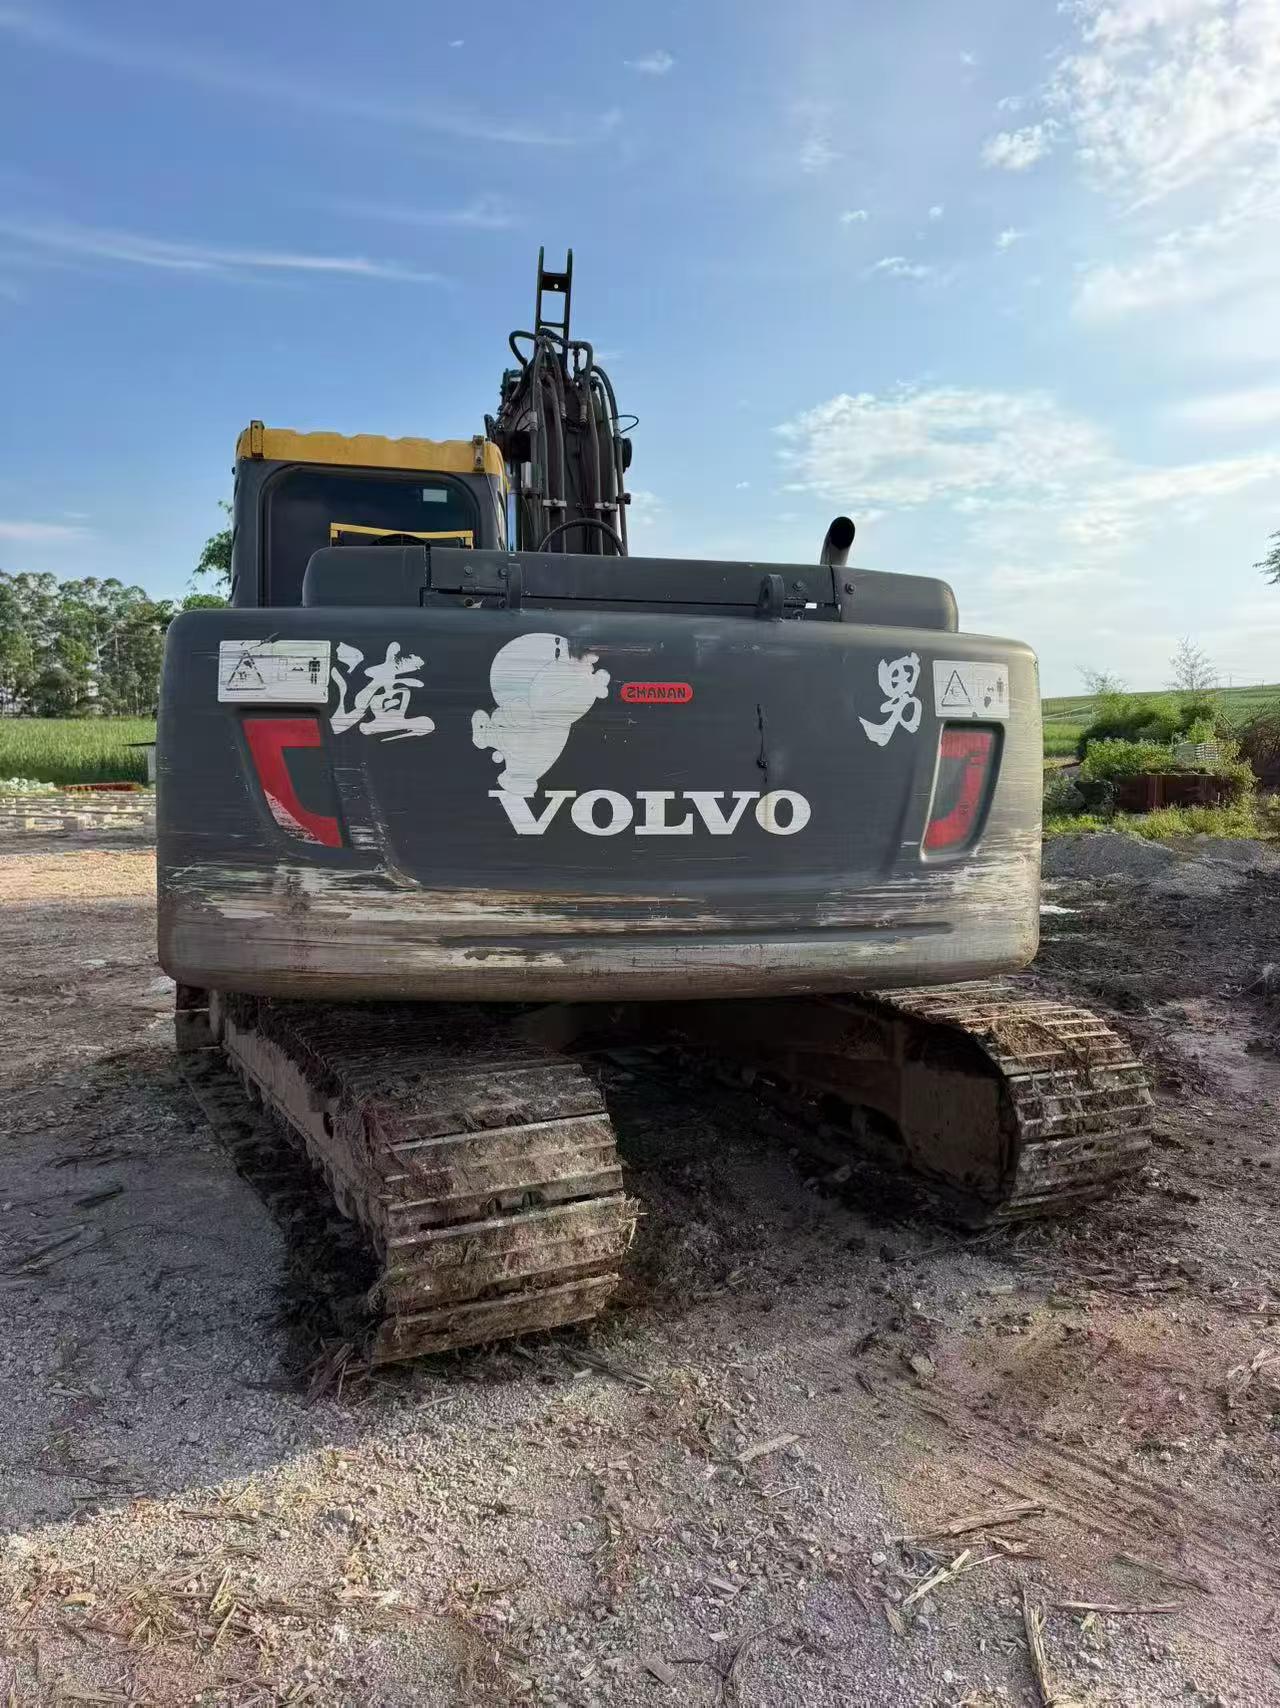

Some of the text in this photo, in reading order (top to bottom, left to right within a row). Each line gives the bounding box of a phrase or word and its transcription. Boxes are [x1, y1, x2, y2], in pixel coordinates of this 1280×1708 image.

[329, 642, 435, 741] 渣
[859, 652, 922, 746] 男
[488, 789, 811, 836] VOLVO
